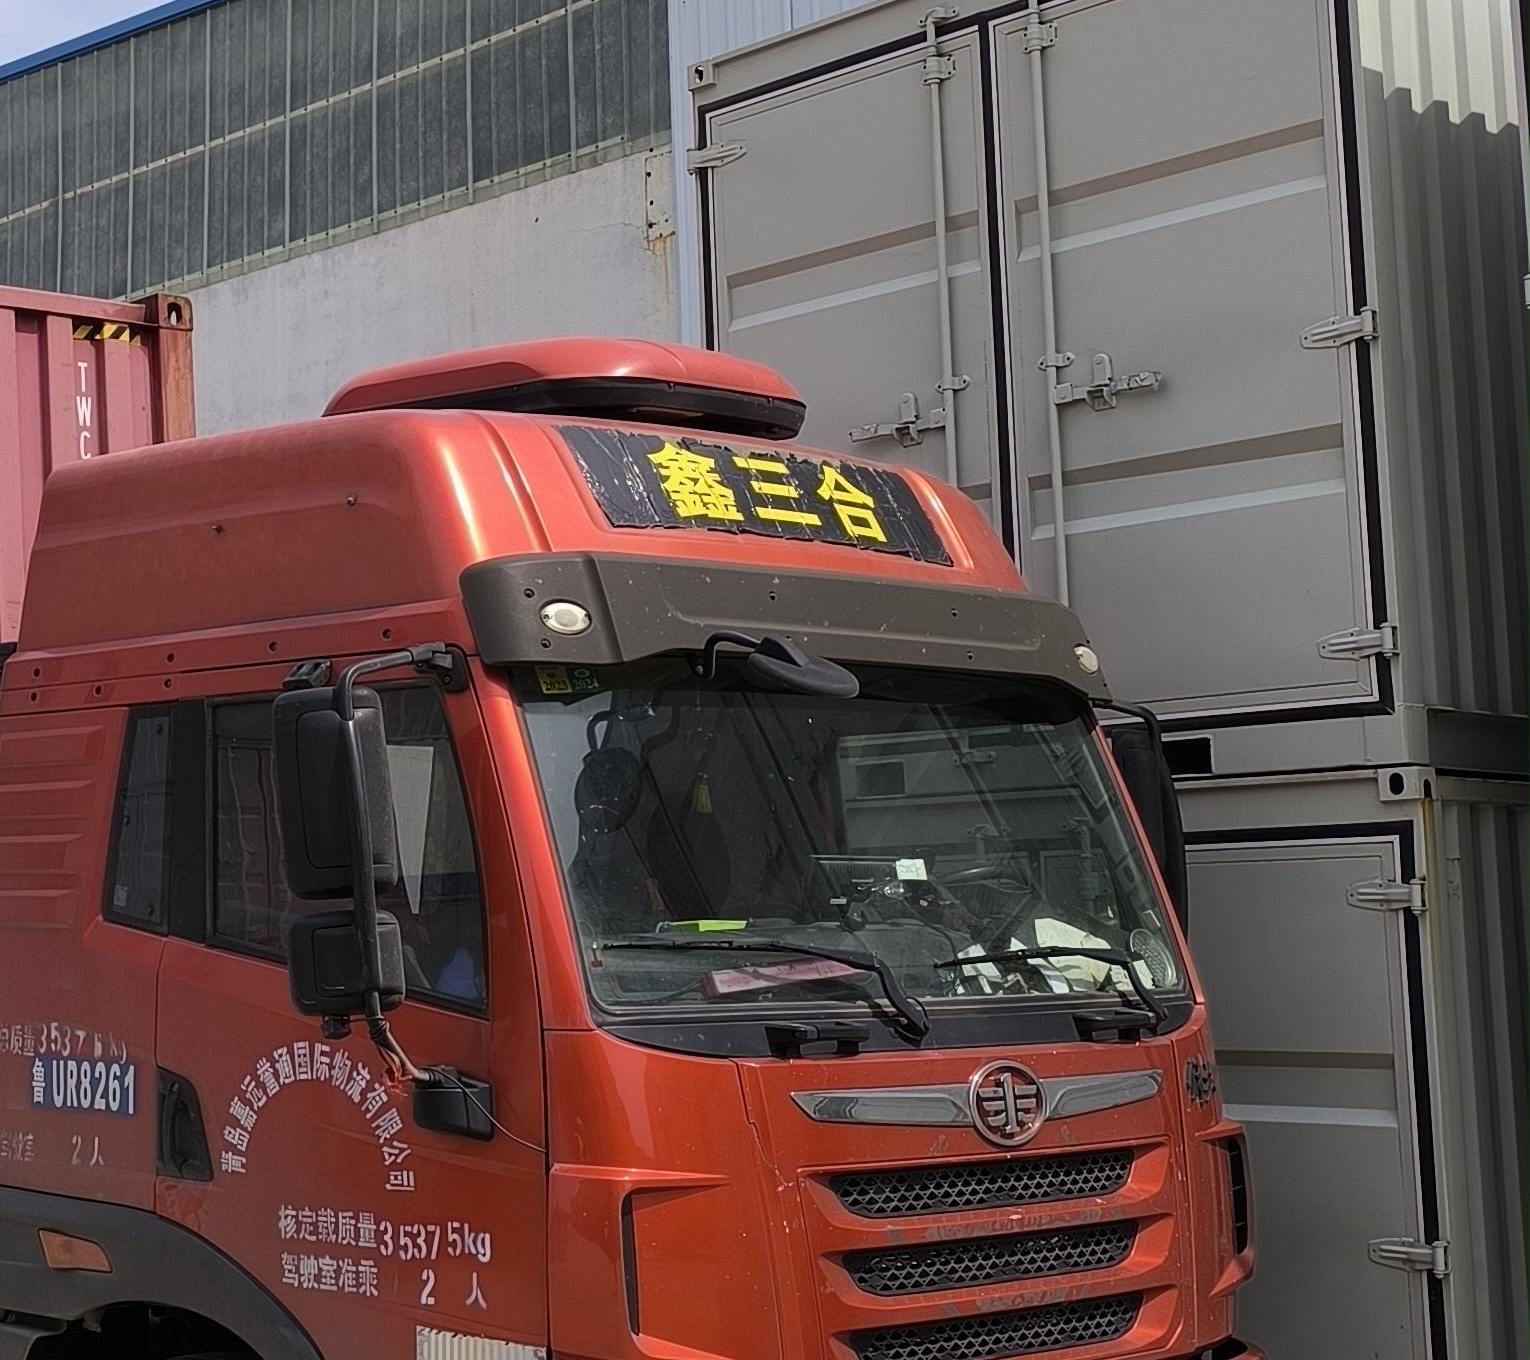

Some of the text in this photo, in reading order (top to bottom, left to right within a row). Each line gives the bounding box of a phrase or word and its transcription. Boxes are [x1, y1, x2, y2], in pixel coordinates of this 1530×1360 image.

[647, 442, 887, 543] 鑫三合
[572, 678, 599, 690] 2024
